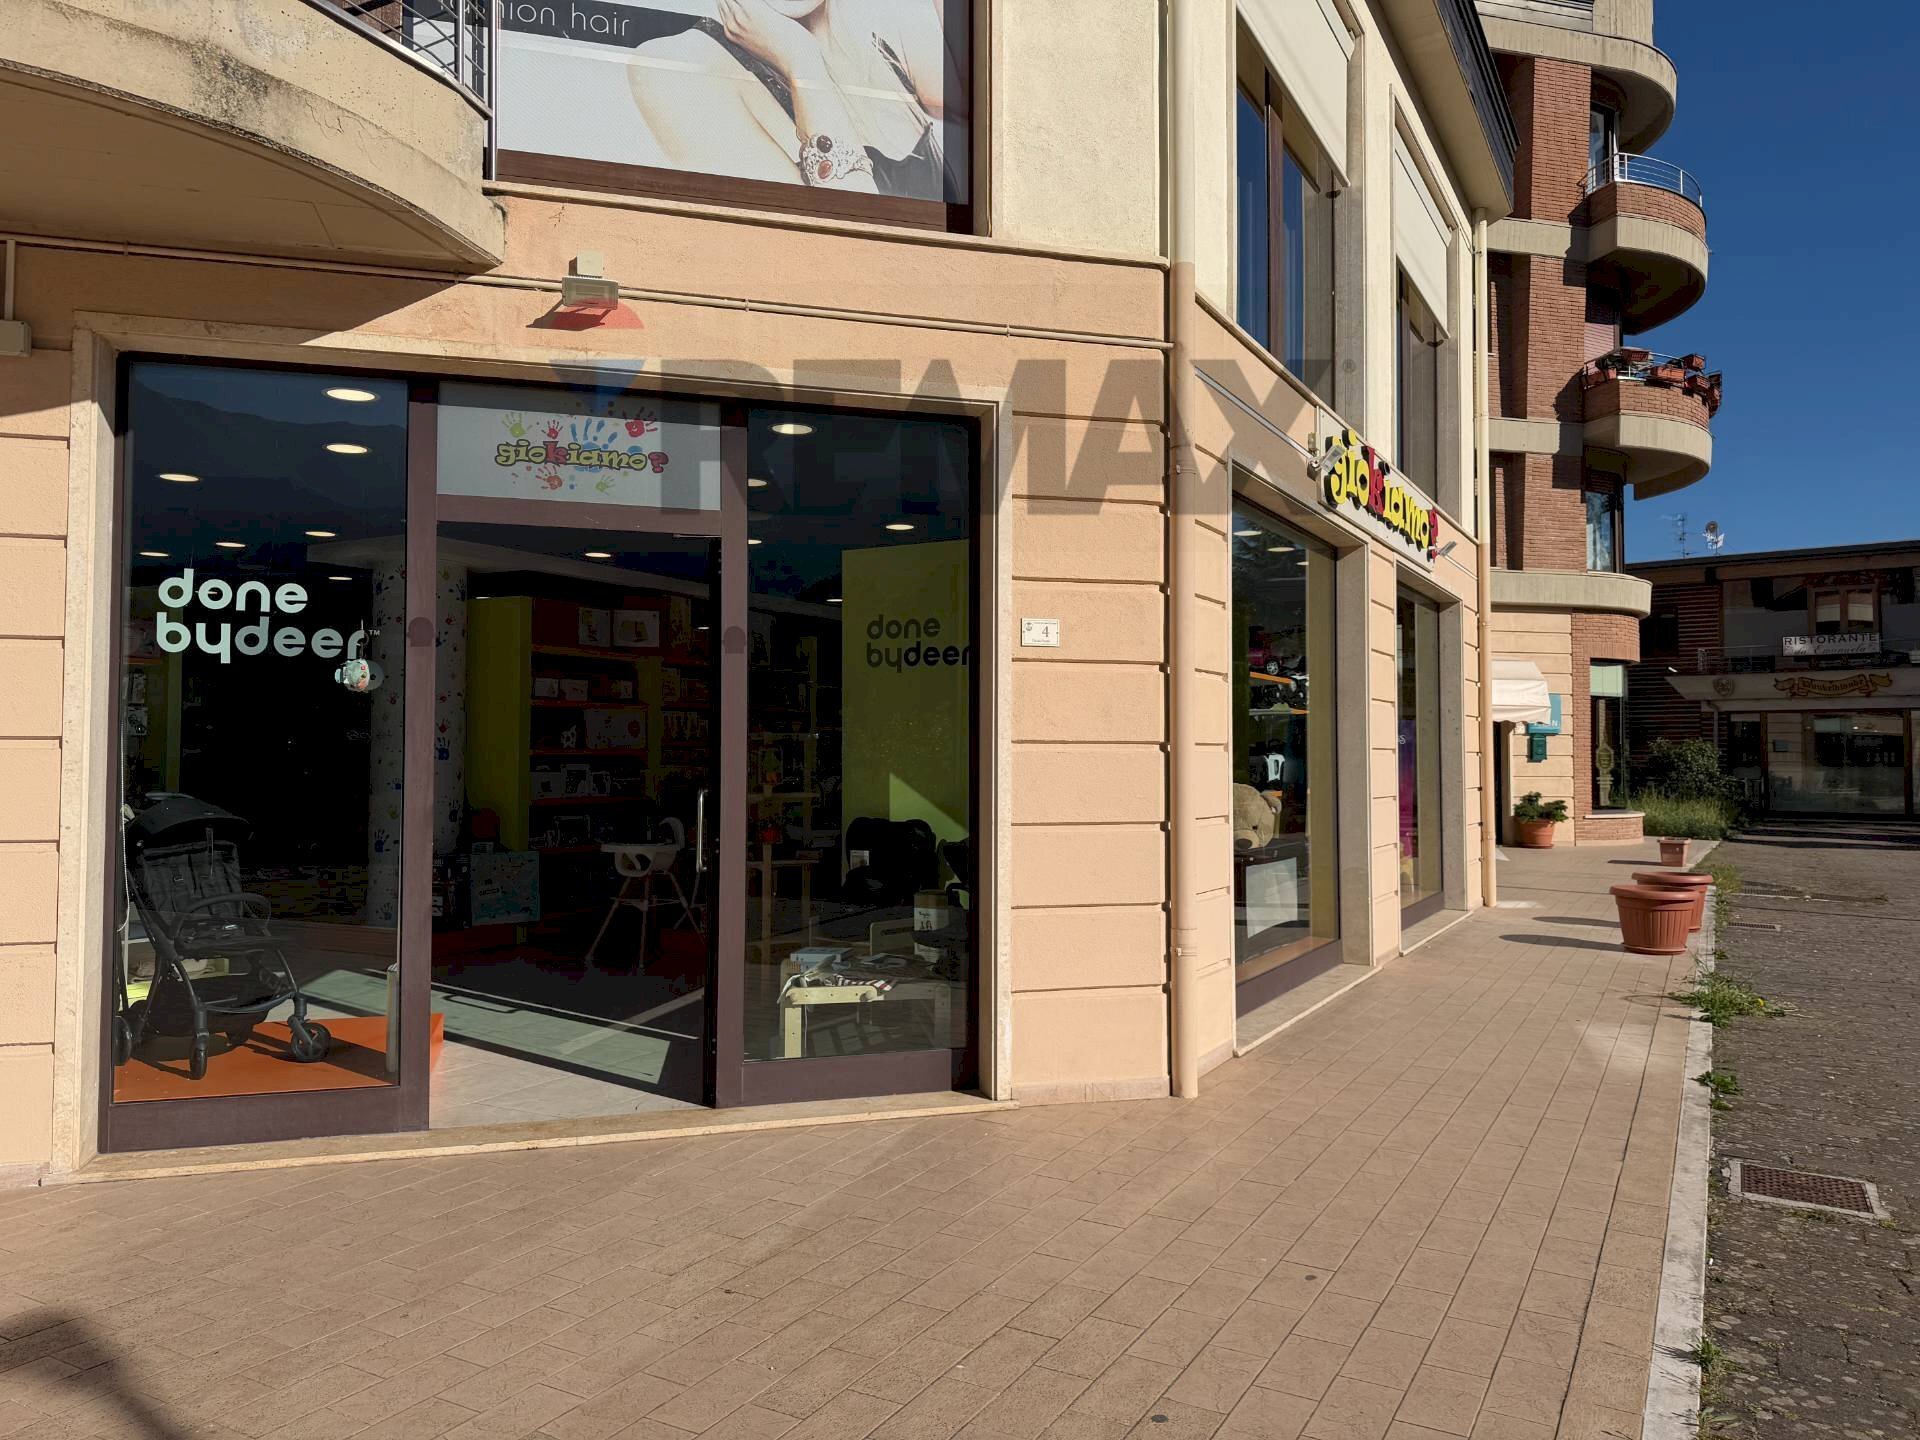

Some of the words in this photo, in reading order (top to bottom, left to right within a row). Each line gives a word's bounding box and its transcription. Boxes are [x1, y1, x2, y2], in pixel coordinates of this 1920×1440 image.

[571, 2, 630, 36] hair
[157, 567, 309, 614] done
[866, 613, 941, 640] done
[1041, 625, 1050, 638] 4
[1784, 632, 1878, 646] RISTORANTE
